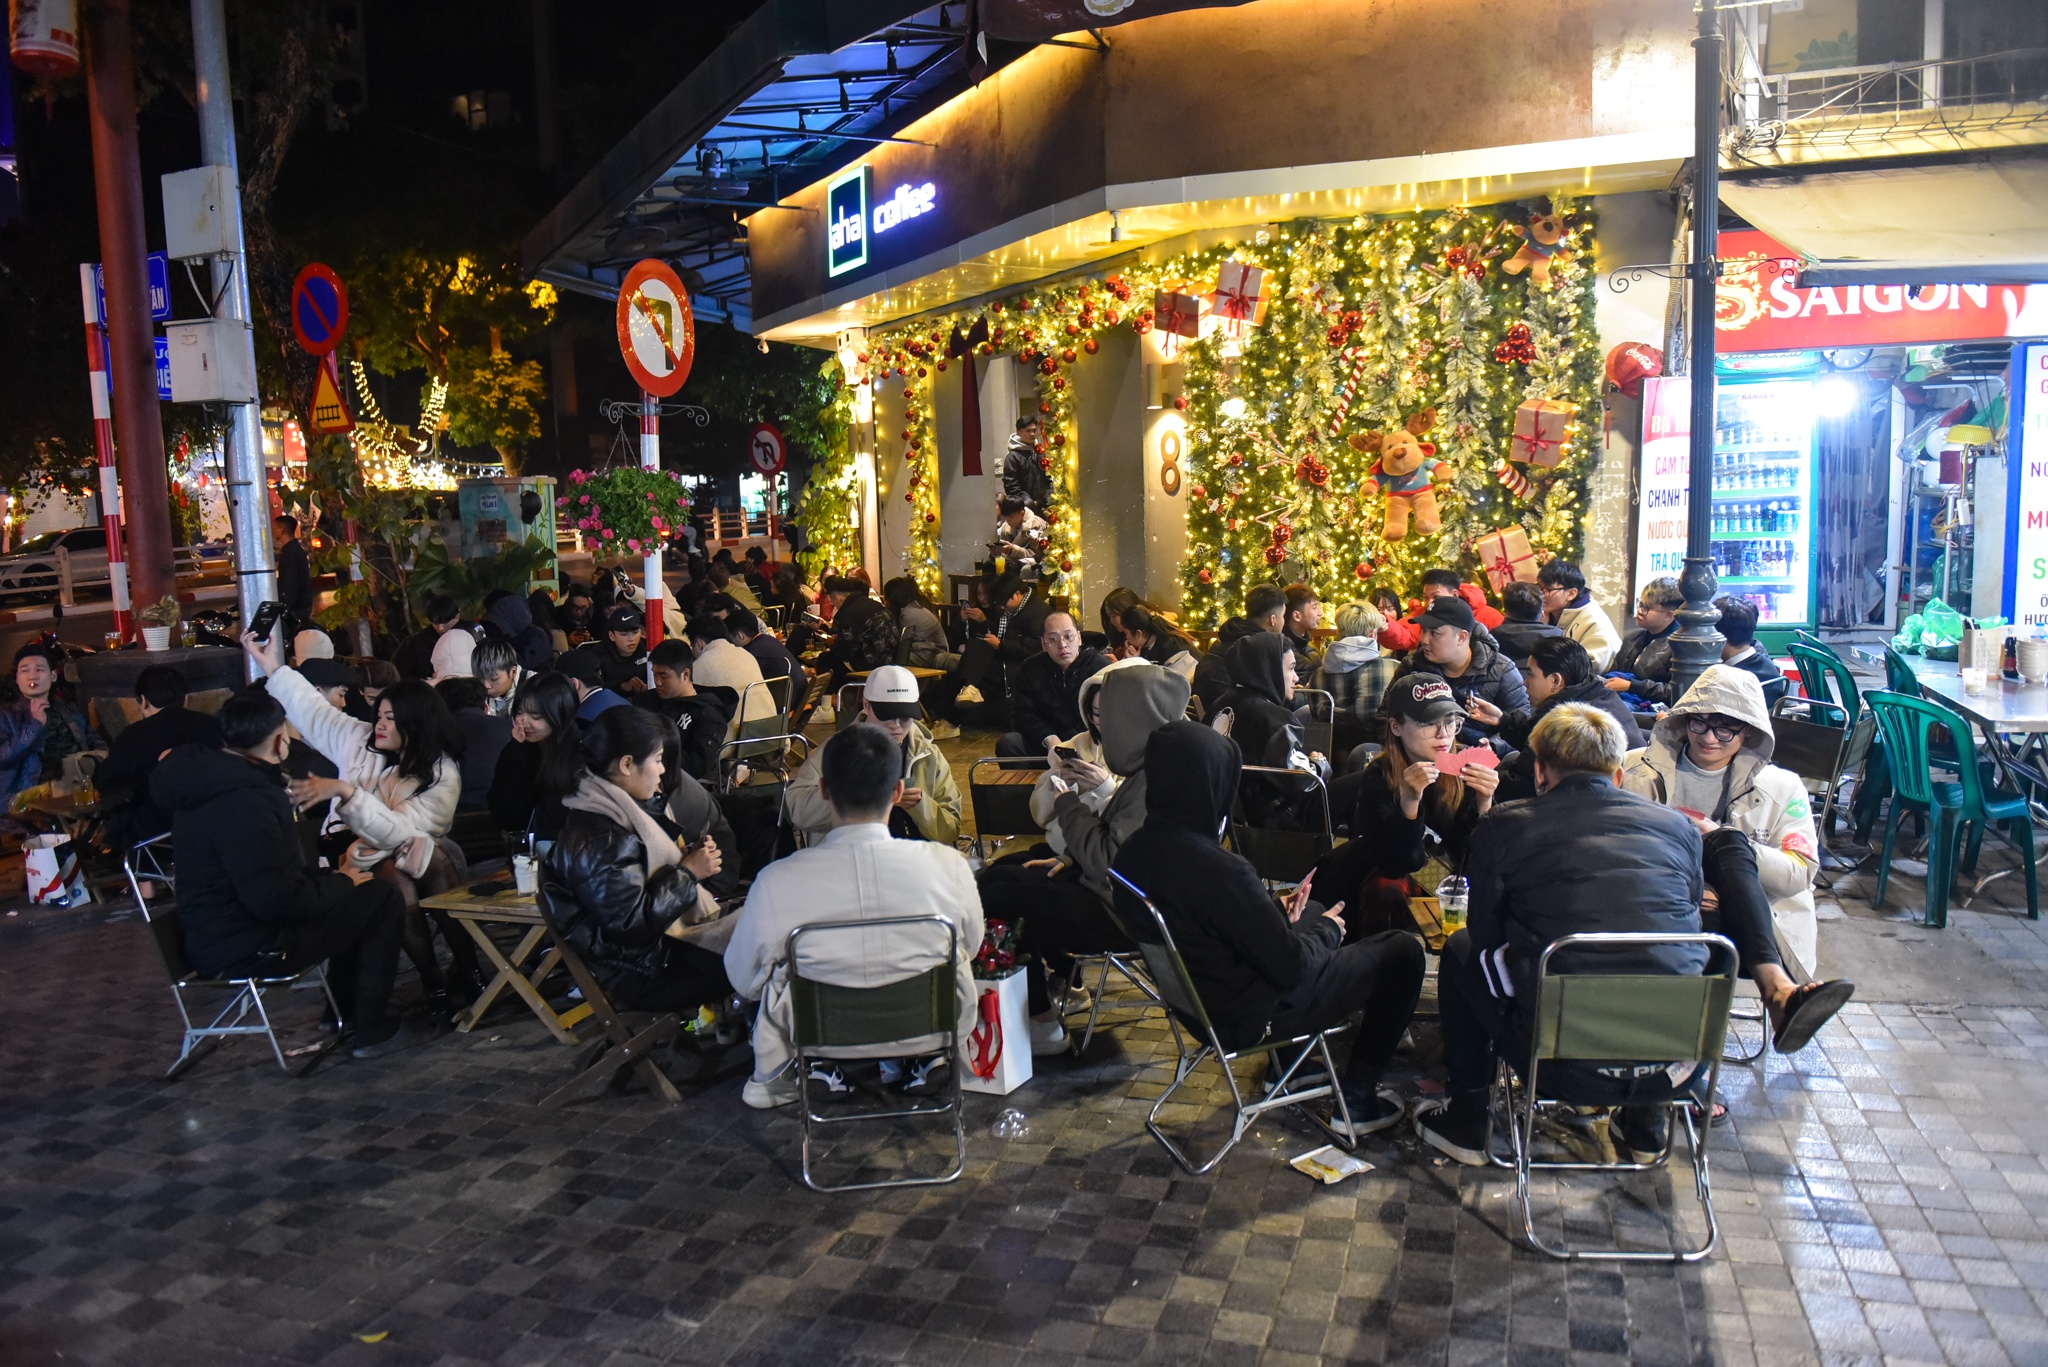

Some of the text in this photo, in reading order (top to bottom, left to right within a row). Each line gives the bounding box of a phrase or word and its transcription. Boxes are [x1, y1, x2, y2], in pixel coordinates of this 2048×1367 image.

[831, 182, 935, 250] aha coffee
[149, 285, 165, 310] ÂN
[1769, 275, 1988, 319] SAIGON
[1161, 429, 1180, 493] 8
[1655, 456, 1677, 475] CAM
[1648, 488, 1681, 508] CHANH
